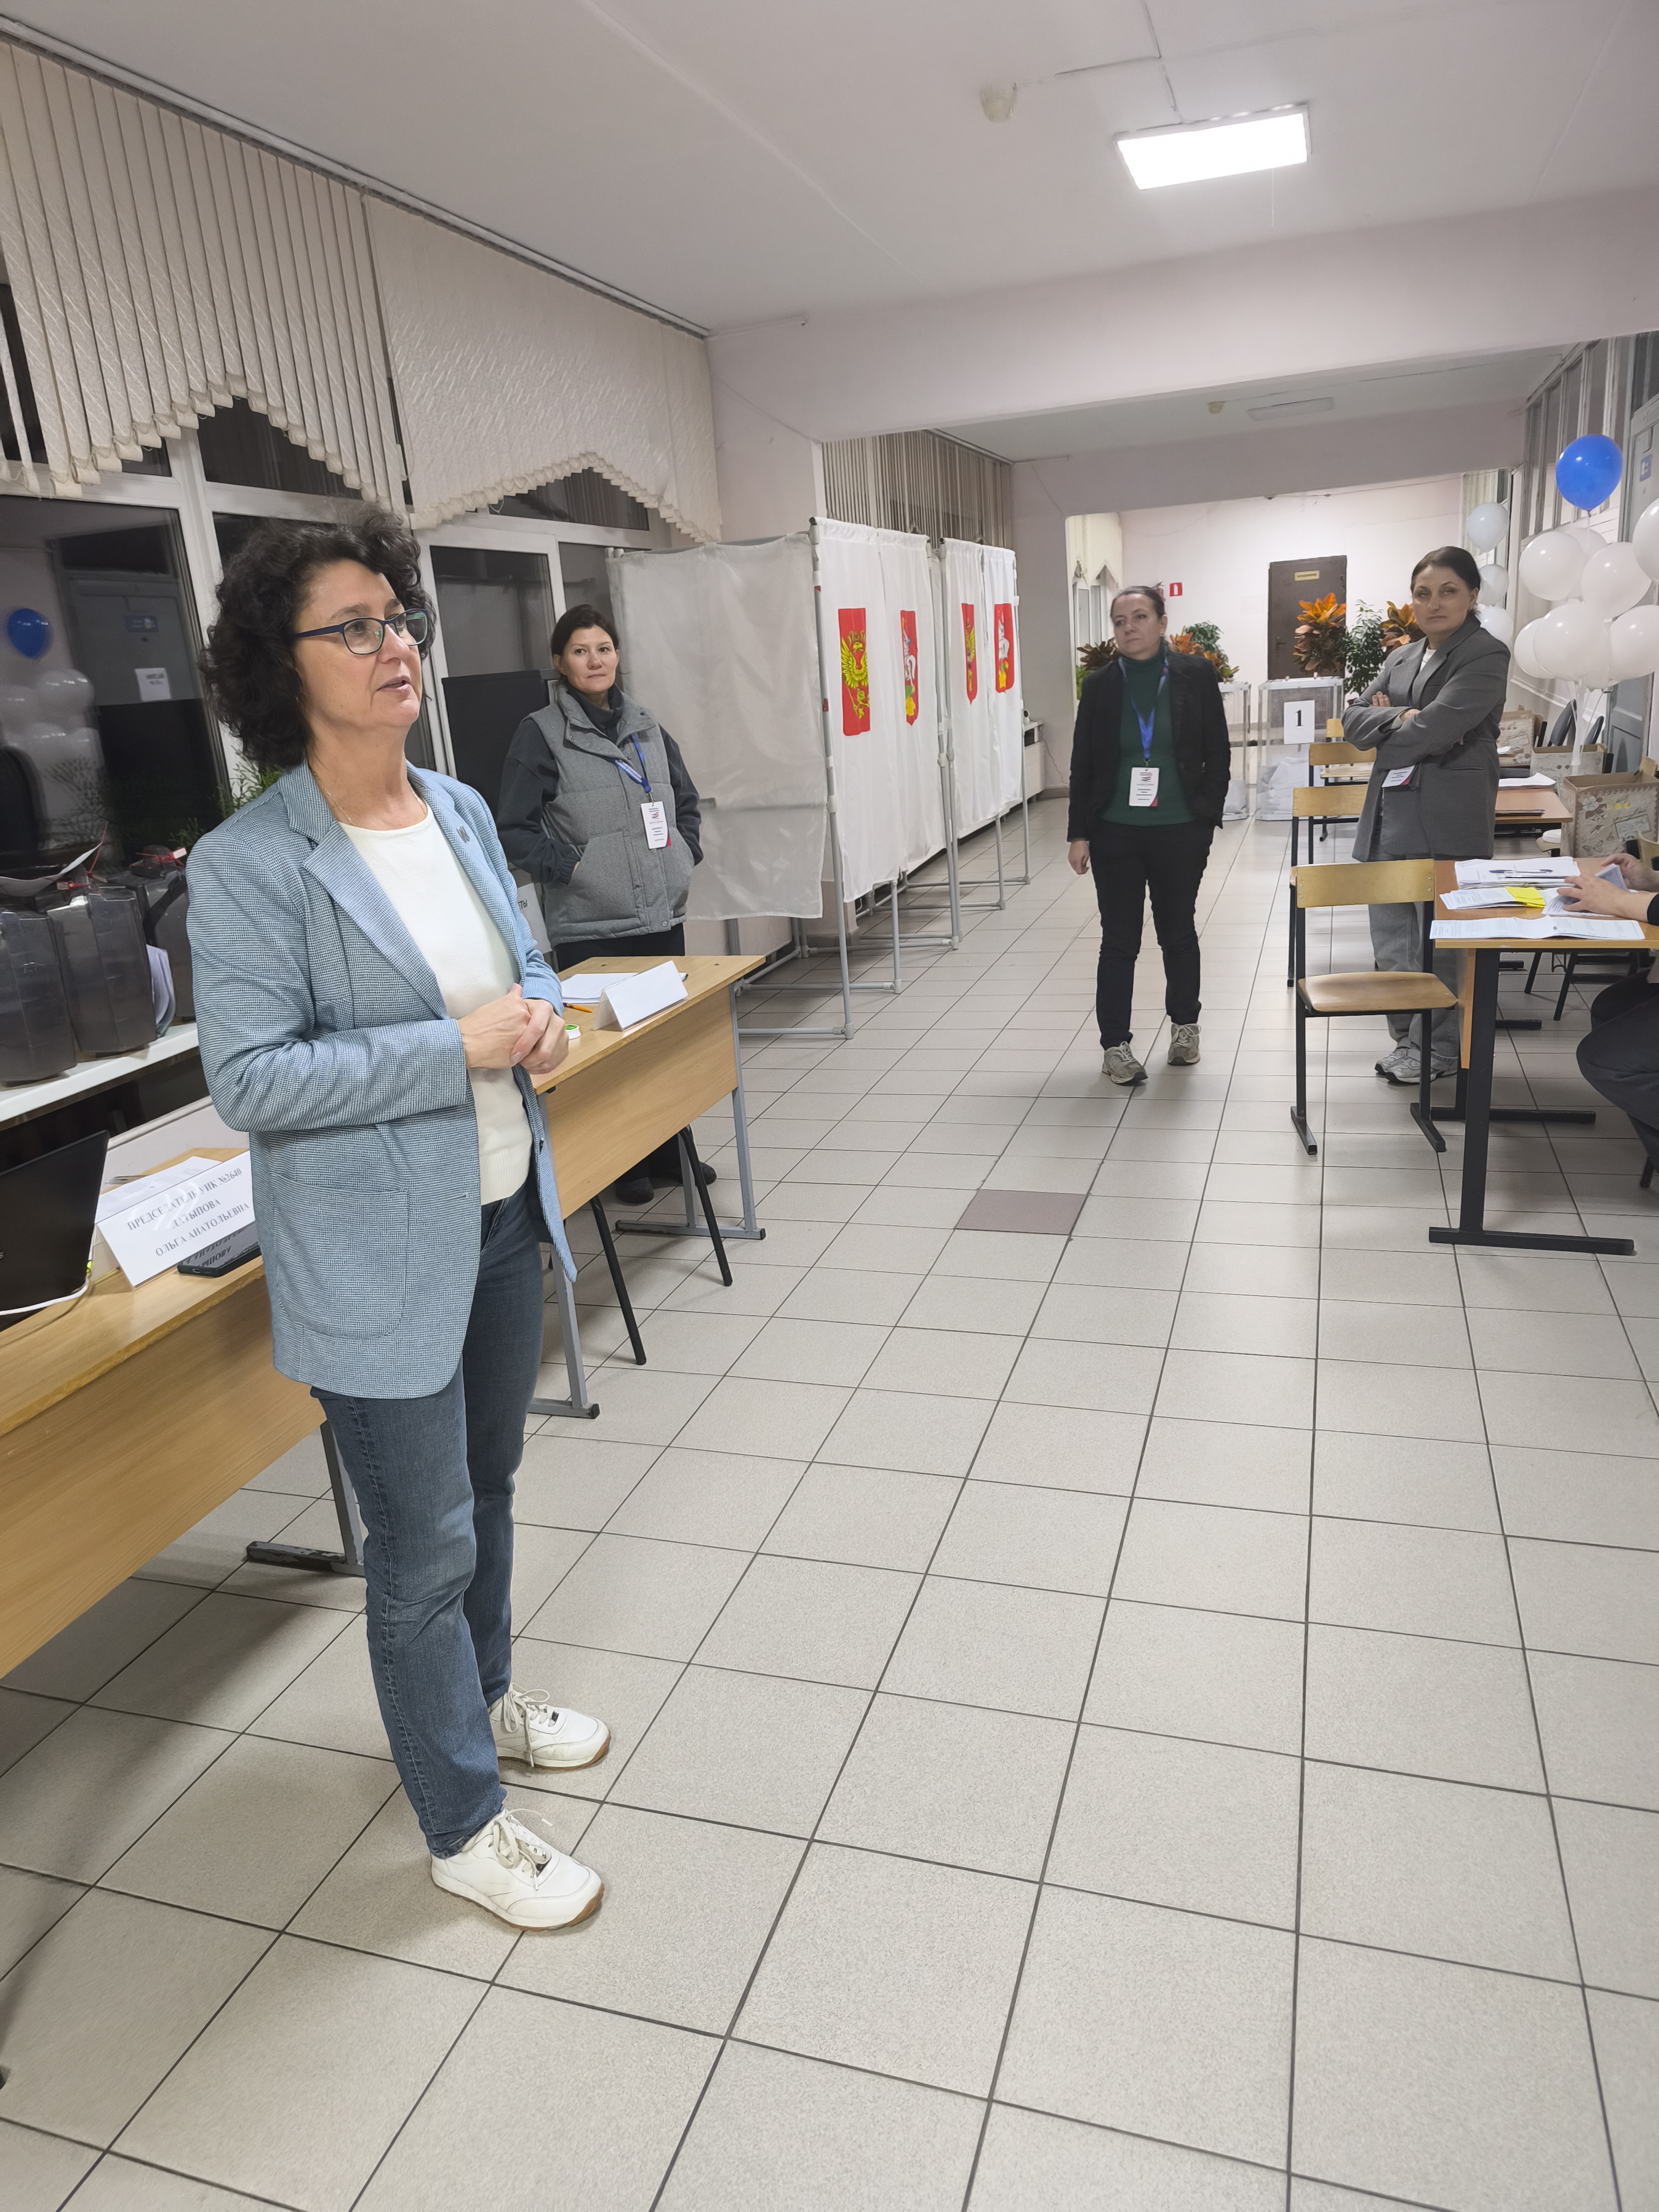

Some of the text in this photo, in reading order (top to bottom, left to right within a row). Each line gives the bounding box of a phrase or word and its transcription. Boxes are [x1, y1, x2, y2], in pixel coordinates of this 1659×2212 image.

[1295, 709, 1304, 727] 1
[127, 1189, 198, 1231] ПРЕДСЕДАТЕЛЬ
[198, 1179, 218, 1194] УИК
[218, 1168, 242, 1185] №2640
[156, 1236, 187, 1256] ОЛЬГА
[188, 1203, 250, 1240] АНАТОЛЬЕВНА
